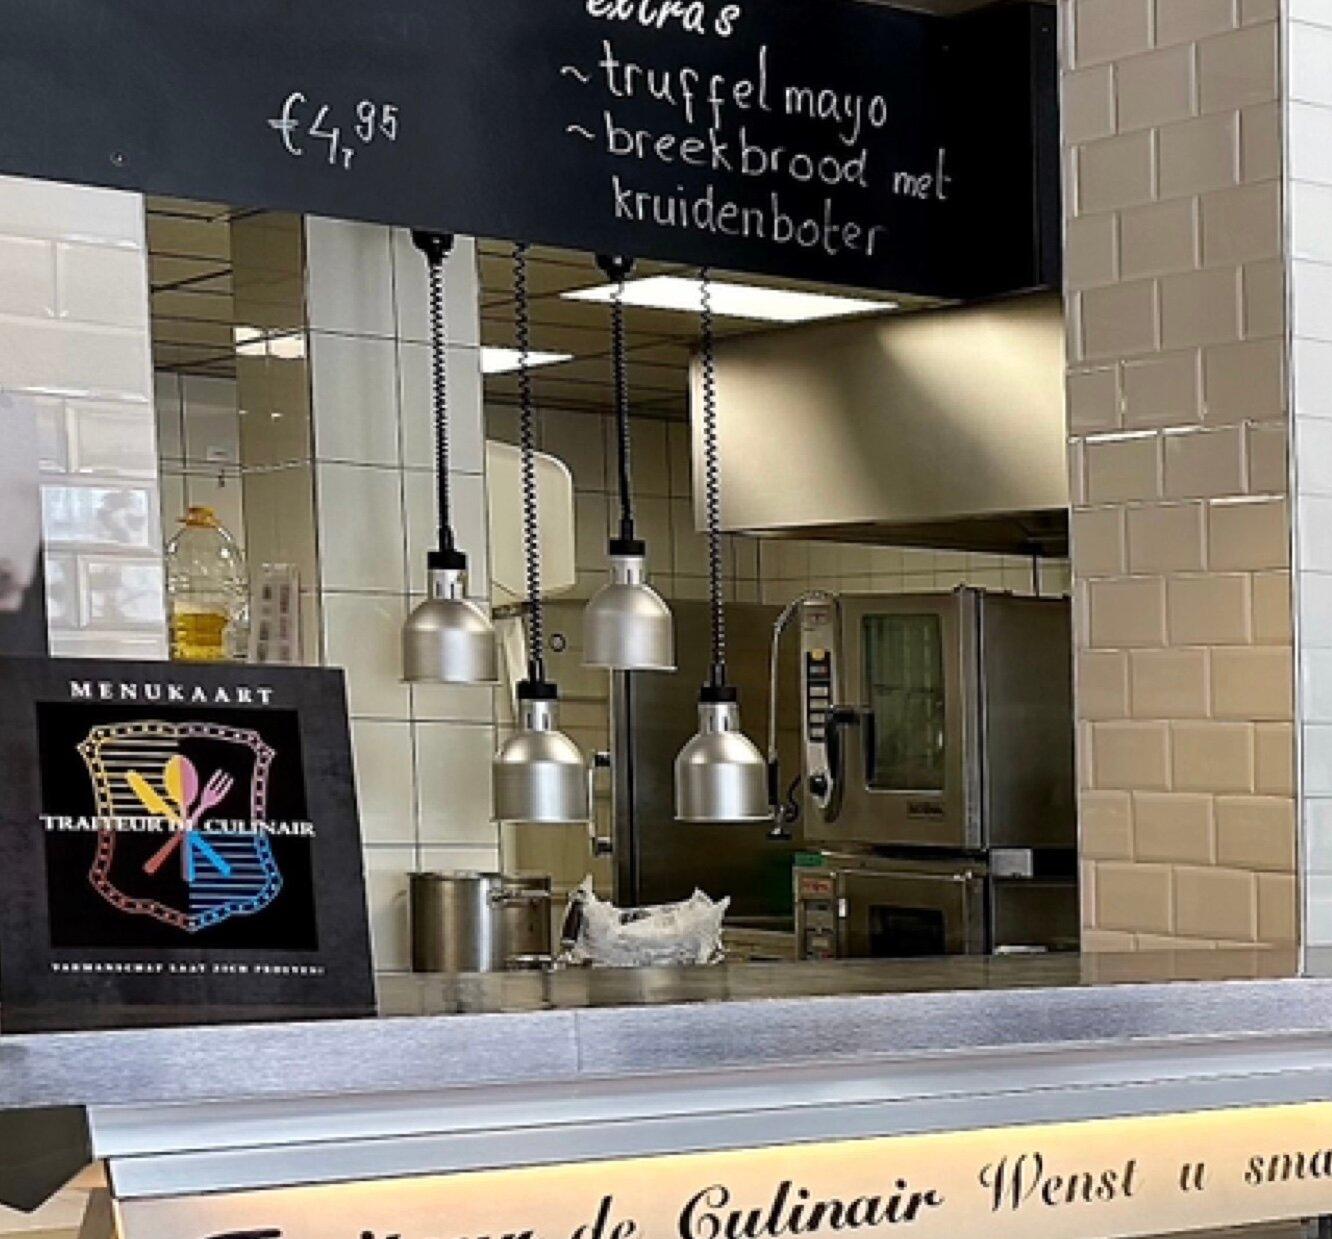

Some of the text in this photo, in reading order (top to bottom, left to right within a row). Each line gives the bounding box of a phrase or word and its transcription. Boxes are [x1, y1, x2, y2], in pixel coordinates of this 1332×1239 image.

[266, 91, 399, 170] €4,95
[784, 86, 888, 146] mayo
[893, 148, 953, 201] met
[612, 174, 889, 256] kruidenboter
[69, 680, 275, 705] MENUKAART
[39, 814, 164, 833] TRAITEUR
[203, 818, 317, 838] CULINAIR
[978, 1150, 1142, 1213] Wenst
[1178, 1161, 1209, 1193] u
